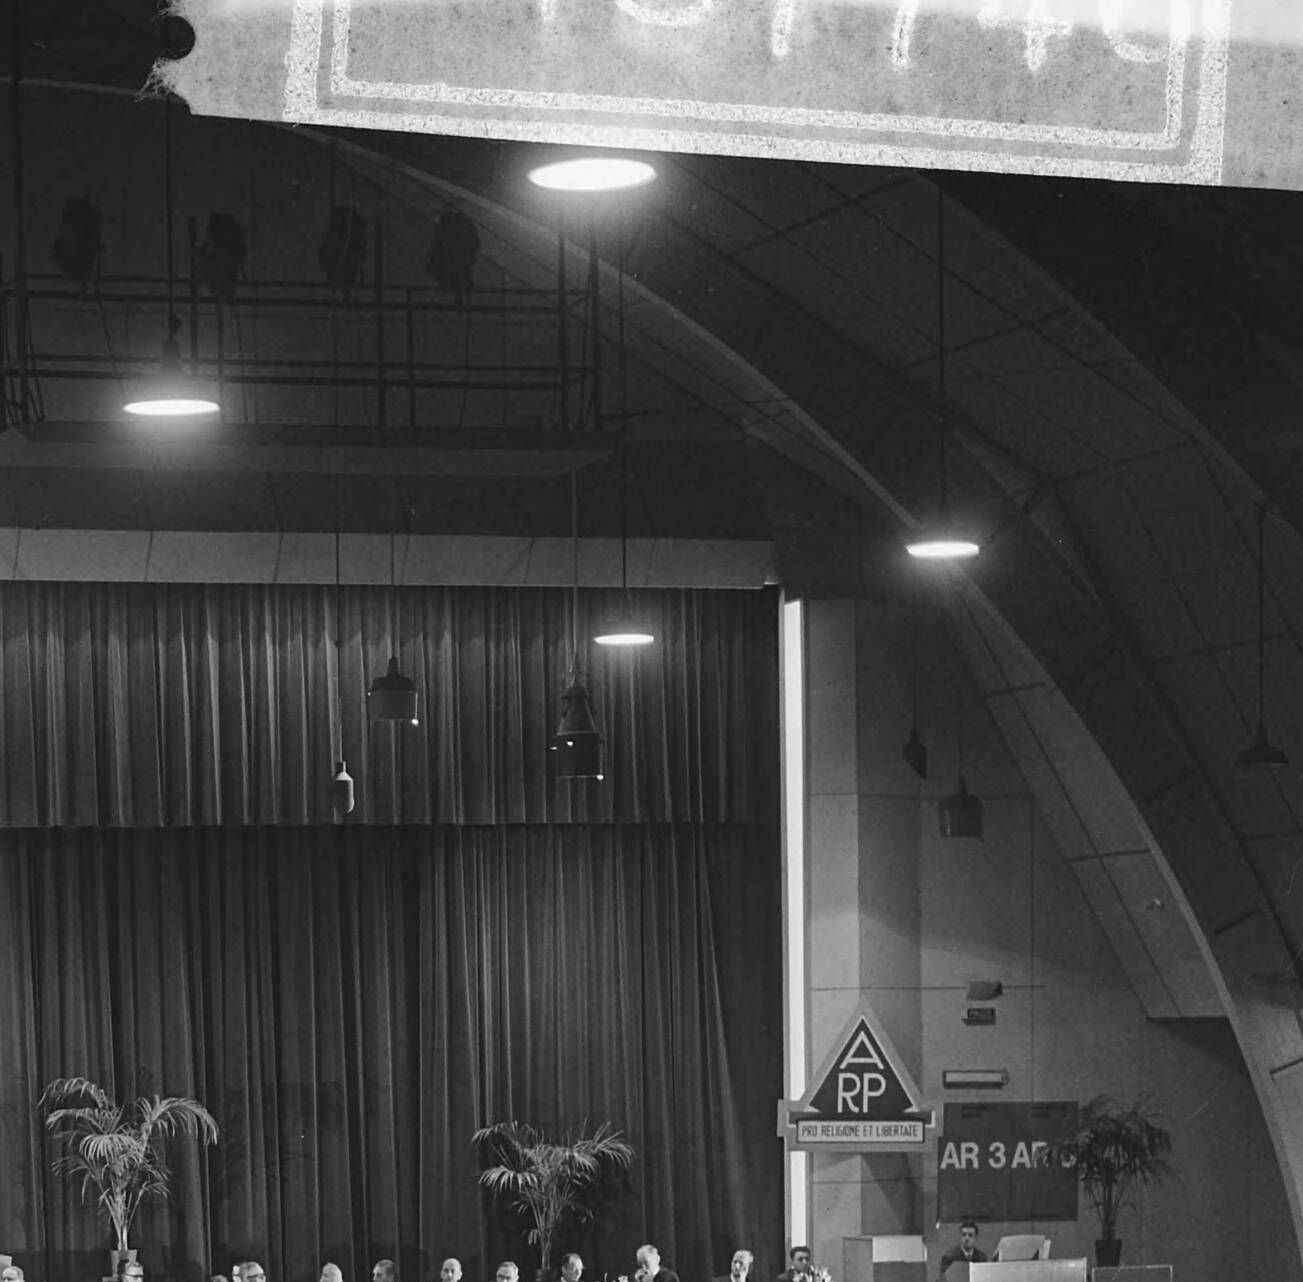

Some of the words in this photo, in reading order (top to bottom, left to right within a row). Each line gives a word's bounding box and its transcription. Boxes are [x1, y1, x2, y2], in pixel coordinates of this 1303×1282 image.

[839, 1031, 885, 1069] A
[837, 1072, 887, 1113] RP
[801, 1124, 818, 1137] PRO
[821, 1124, 861, 1137] RELIGIONE
[863, 1124, 873, 1137] ET
[876, 1124, 919, 1137] LIBERTATE
[940, 1141, 980, 1169] AR
[988, 1141, 1007, 1169] 3
